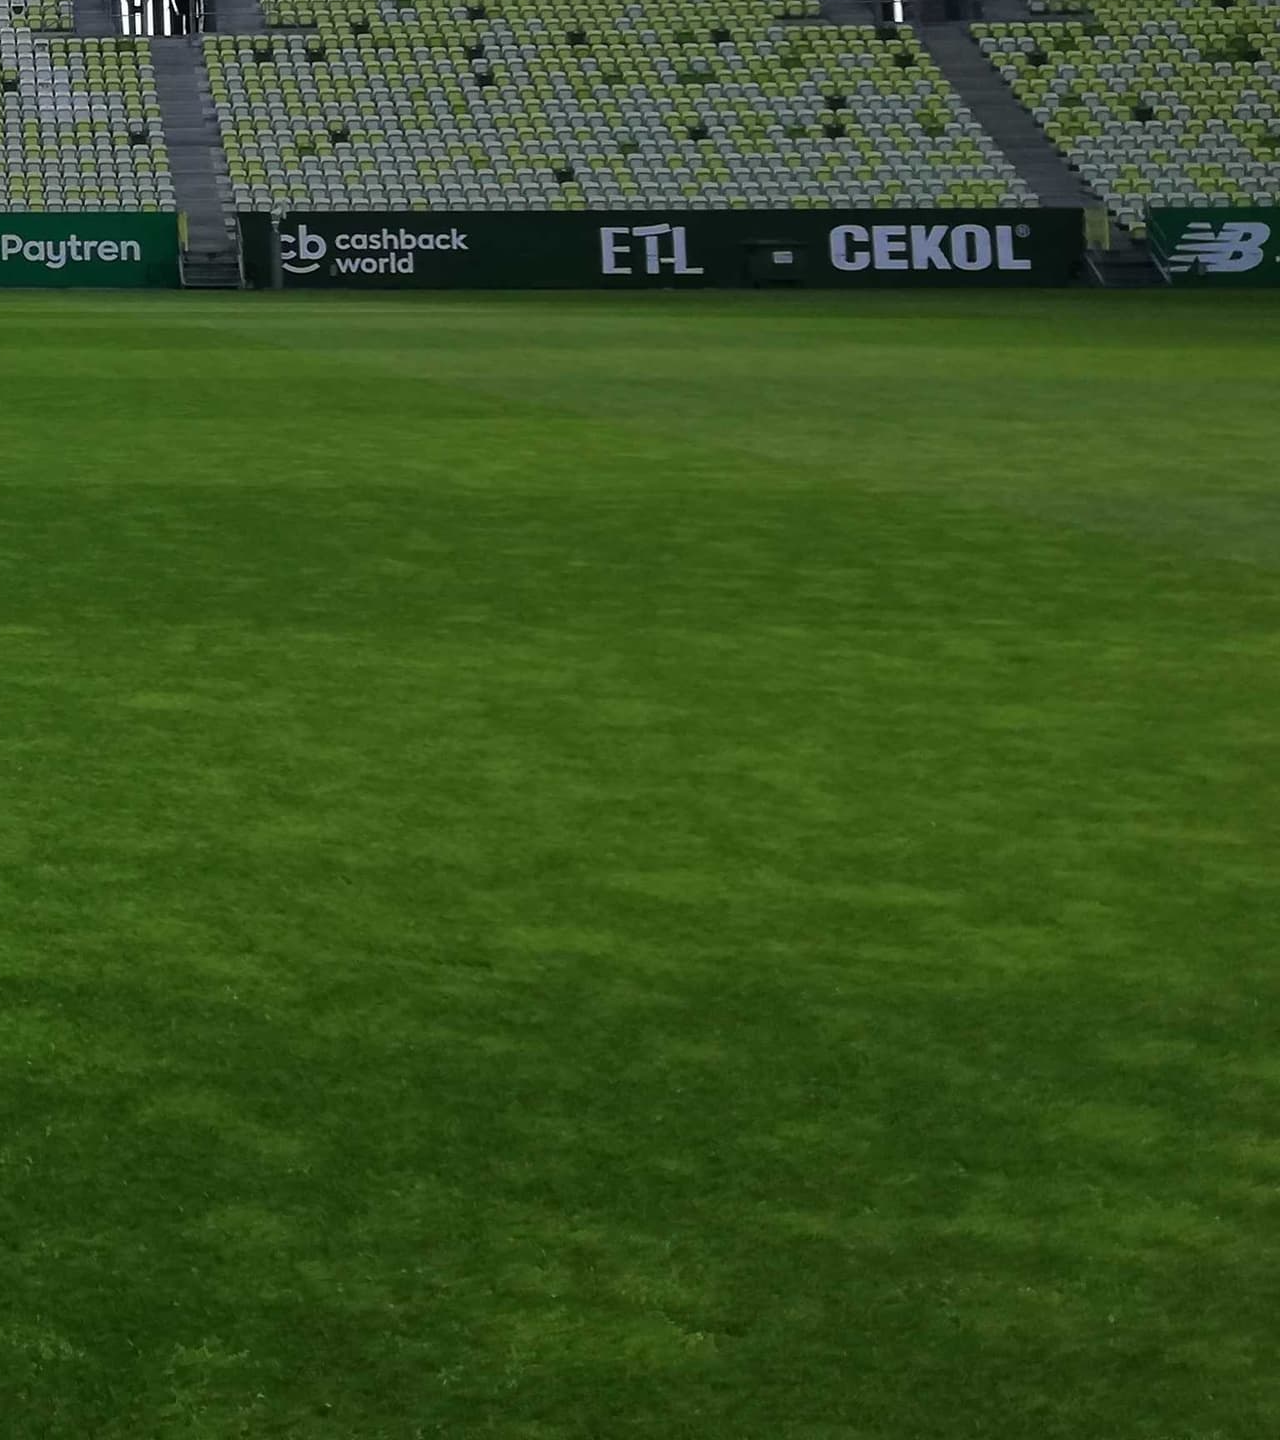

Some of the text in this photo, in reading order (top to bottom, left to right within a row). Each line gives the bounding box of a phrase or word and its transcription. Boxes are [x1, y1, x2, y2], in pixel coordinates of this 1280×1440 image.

[1, 234, 141, 269] Paytren
[334, 228, 469, 251] cashback
[599, 223, 704, 275] ETL
[335, 252, 414, 274] world
